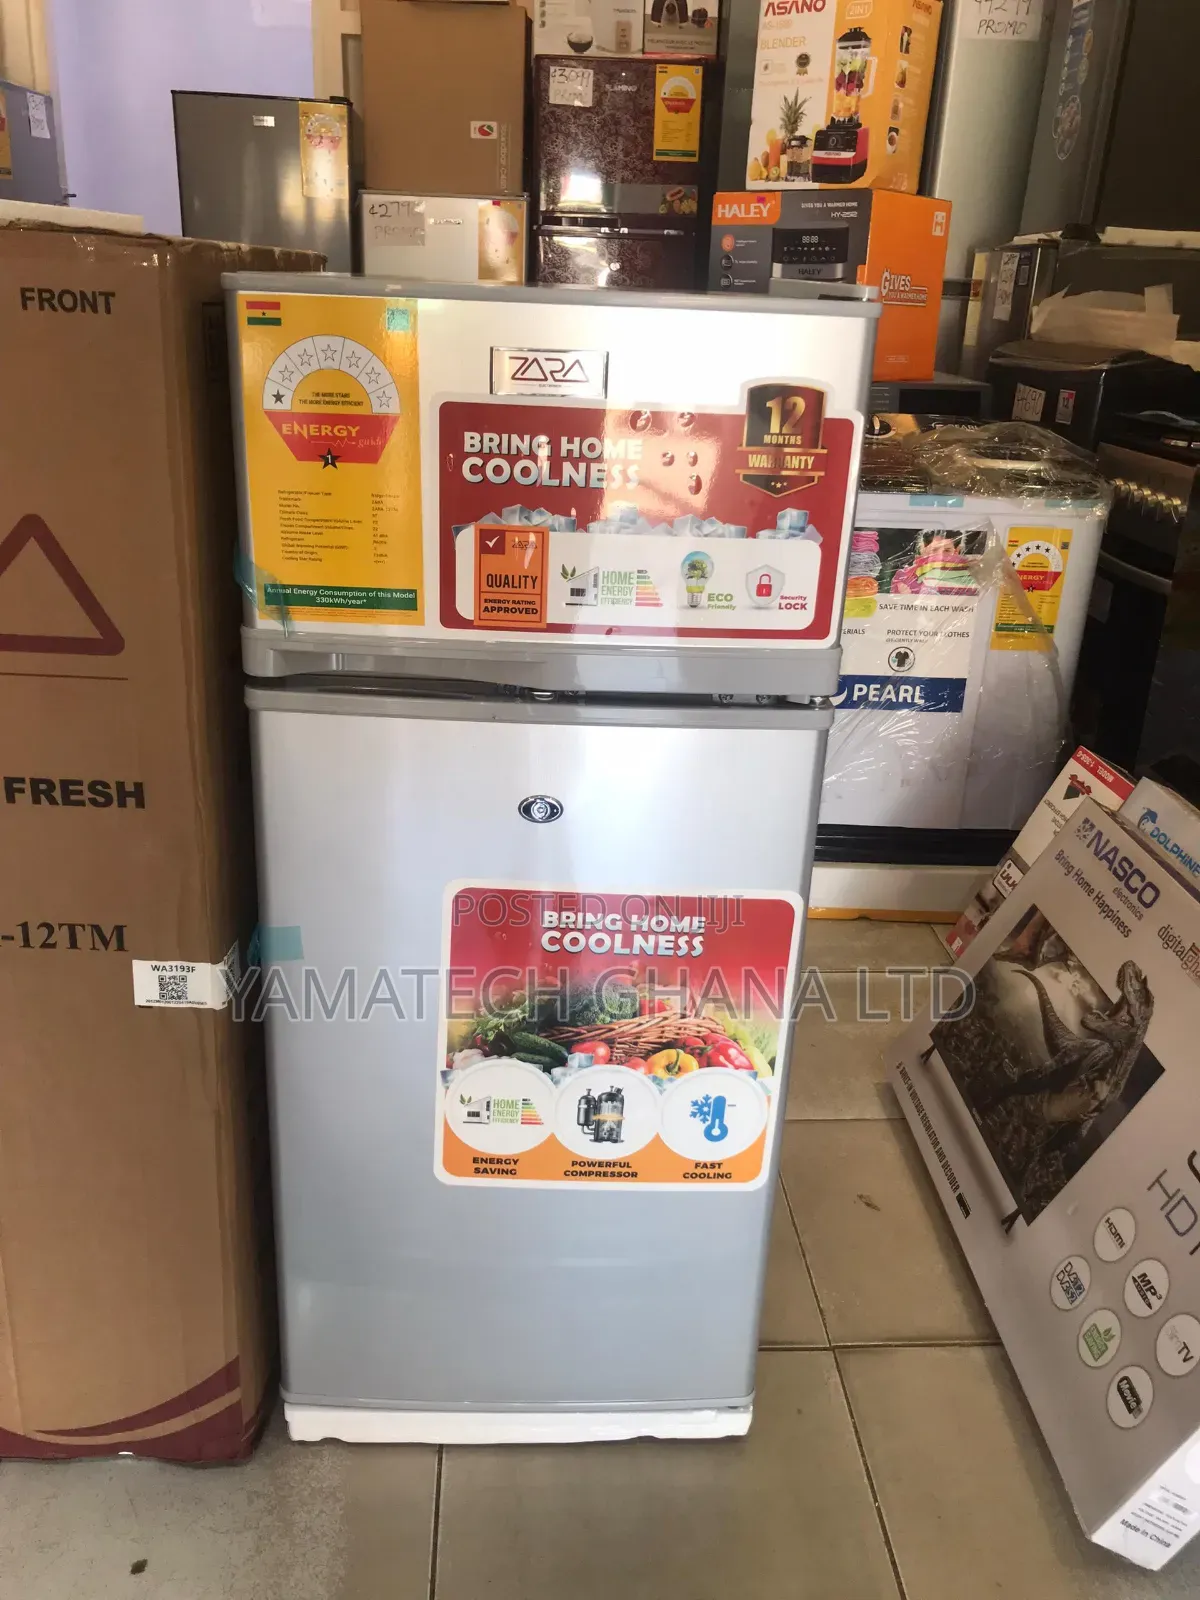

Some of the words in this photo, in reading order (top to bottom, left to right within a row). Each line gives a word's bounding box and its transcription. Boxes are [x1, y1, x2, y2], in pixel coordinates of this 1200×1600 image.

[977, 19, 1028, 36] PROMO
[760, 36, 808, 50] BLENDER
[717, 203, 772, 218] HALEY
[881, 268, 911, 297] GIVES
[20, 287, 116, 315] FRONT
[508, 355, 590, 383] ZARA
[765, 396, 806, 434] 12
[281, 421, 361, 440] ENERGY
[463, 431, 552, 456] BRING
[560, 436, 644, 461] HOME
[763, 434, 802, 445] MONTHS
[461, 456, 641, 490] COOLNESS
[486, 573, 539, 590] QUALITY
[602, 570, 635, 585] HOME
[267, 587, 292, 595] Annual
[294, 588, 318, 597] Energy
[320, 589, 369, 599] Consumption
[601, 586, 634, 597] ENERGY
[708, 593, 734, 602] ECO
[600, 597, 633, 605] EFFICIENCY
[707, 603, 737, 611] Friendly
[778, 602, 808, 611] LOCK
[879, 603, 898, 611] SAVE
[483, 606, 539, 615] APPROVED
[887, 629, 918, 637] PROTECT
[852, 683, 925, 704] PEARL
[3, 776, 146, 809] FRESH
[1086, 829, 1161, 909] NASCO
[1054, 848, 1075, 877] Bring
[1074, 867, 1095, 897] Home
[1093, 890, 1132, 939] Happiness
[1112, 885, 1144, 922] electronics
[542, 911, 621, 931] BRING
[630, 914, 706, 934] HOME
[541, 931, 705, 957] COOLNESS
[150, 964, 196, 974] WA3193F
[493, 1098, 521, 1109] HOME
[492, 1109, 520, 1117] ENERGY
[472, 1157, 520, 1166] ENERGY
[571, 1160, 632, 1169] POWERFUL
[694, 1162, 723, 1170] FAST
[473, 1166, 518, 1176] SAVING
[563, 1169, 638, 1178] COMPRESSOR
[683, 1171, 732, 1180] COOLING
[941, 1159, 960, 1194] DECODER
[1137, 1272, 1163, 1302] MP3
[1177, 1341, 1195, 1364] TV
[1118, 1377, 1139, 1411] Movie
[1119, 1518, 1141, 1533] Made
[1141, 1528, 1149, 1538] in
[1149, 1533, 1172, 1549] China
